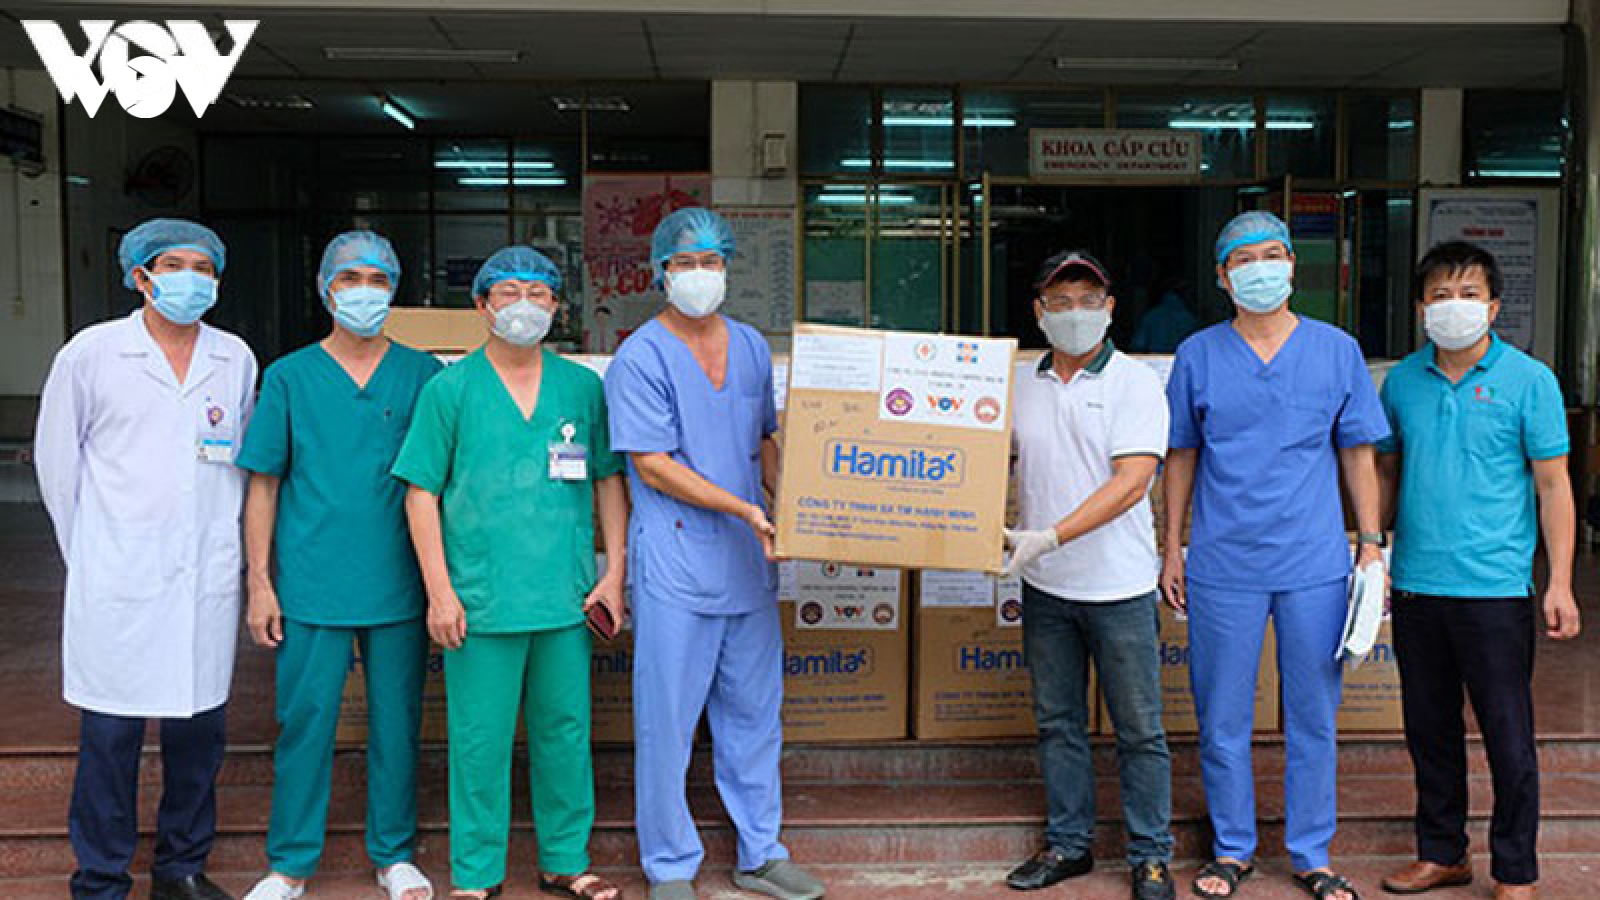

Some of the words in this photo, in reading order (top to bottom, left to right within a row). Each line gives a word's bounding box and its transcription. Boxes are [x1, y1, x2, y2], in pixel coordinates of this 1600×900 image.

[1041, 139, 1097, 157] KHOA
[1103, 133, 1144, 157] CẤP
[832, 443, 955, 480] Hamita
[959, 646, 1022, 670] Ham
